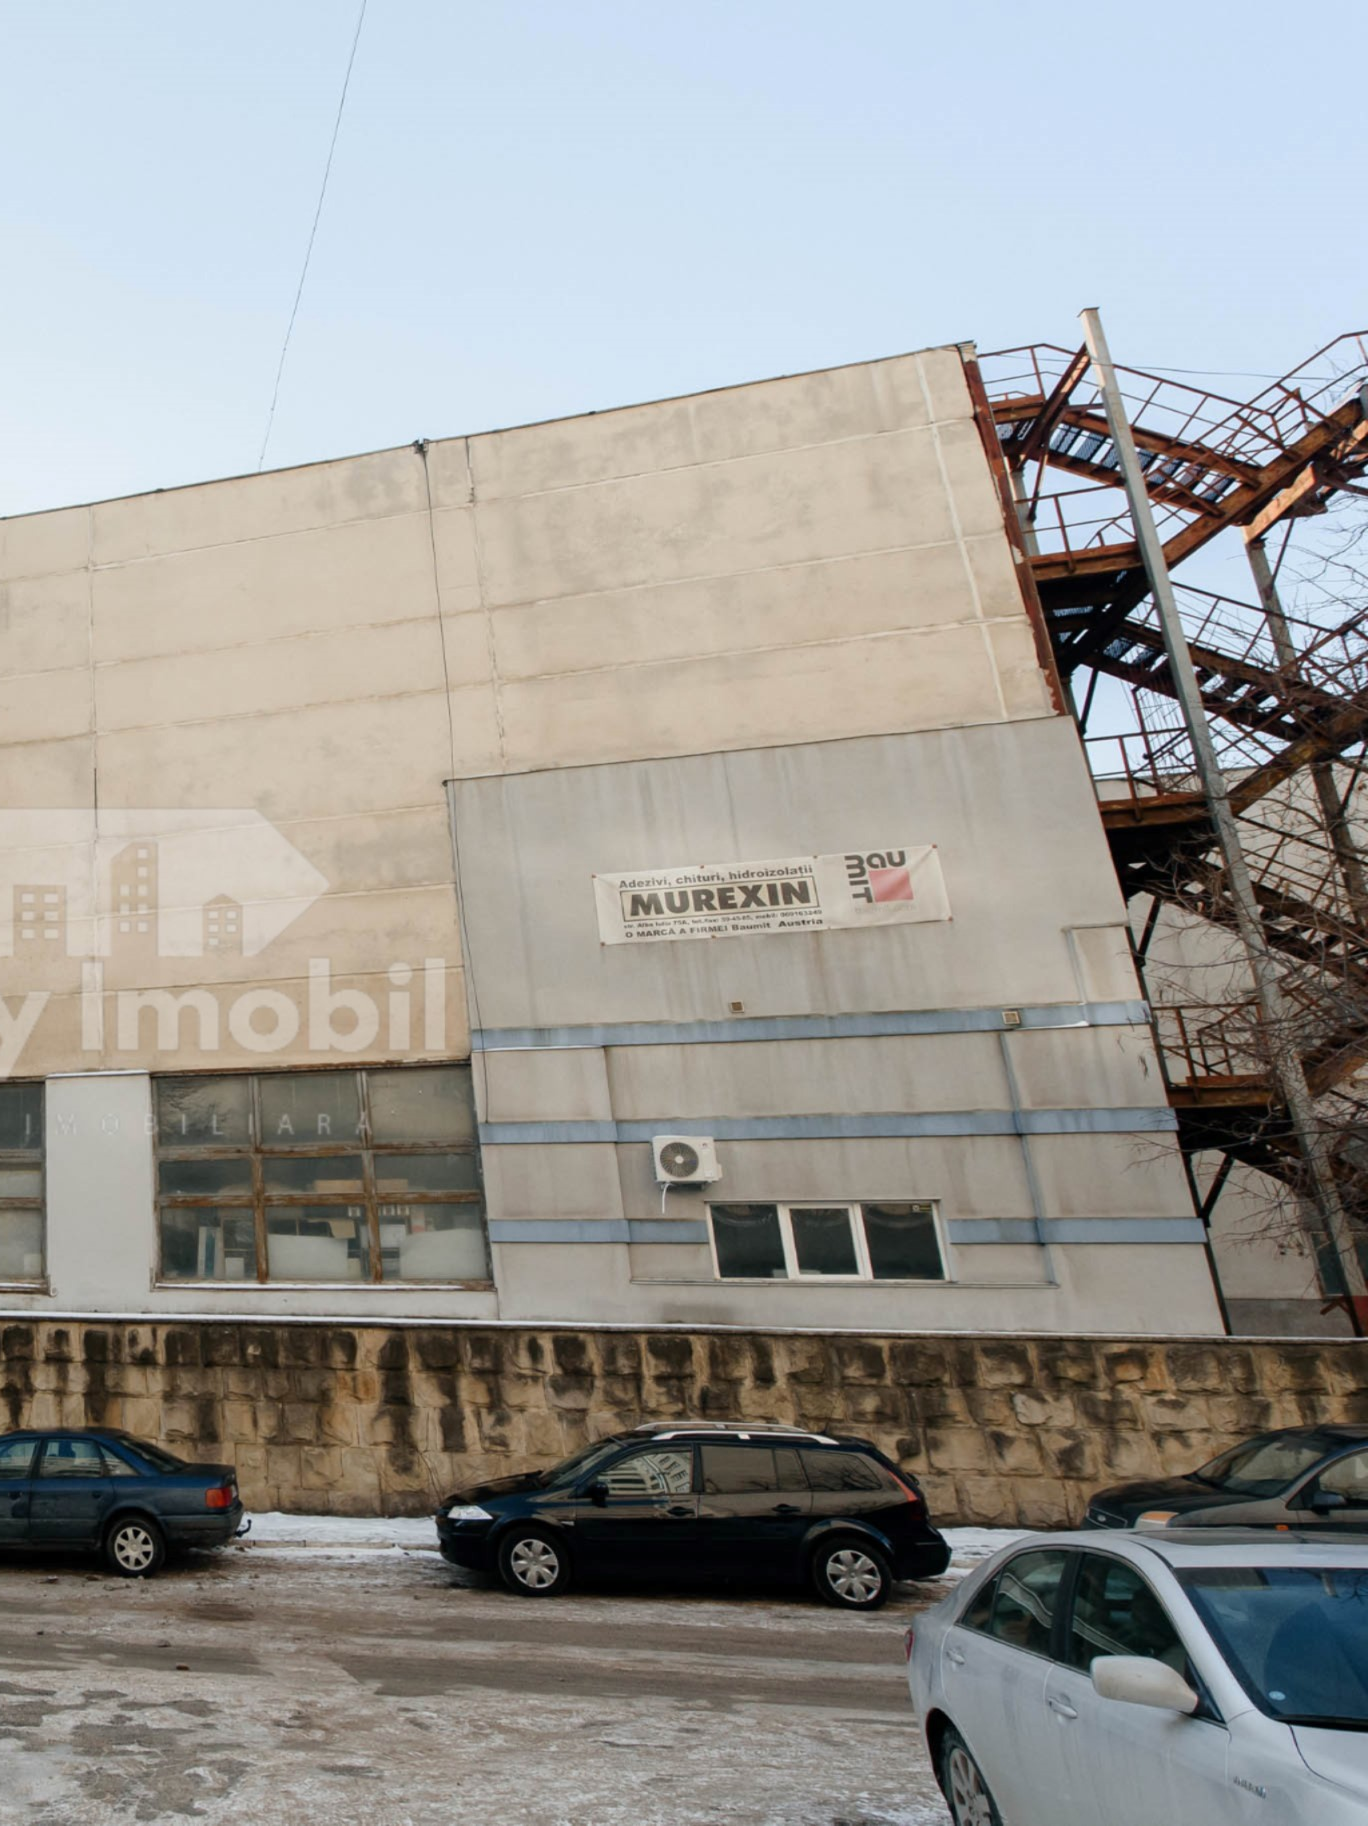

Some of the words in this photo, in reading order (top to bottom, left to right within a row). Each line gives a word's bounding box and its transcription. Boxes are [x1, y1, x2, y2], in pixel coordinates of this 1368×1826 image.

[619, 875, 672, 889] Adezivi,
[675, 872, 725, 885] chituri,
[630, 880, 811, 917] MUREXIN
[690, 924, 728, 934] FIRMEI
[732, 921, 771, 932] Baumit
[778, 917, 823, 928] Austria
